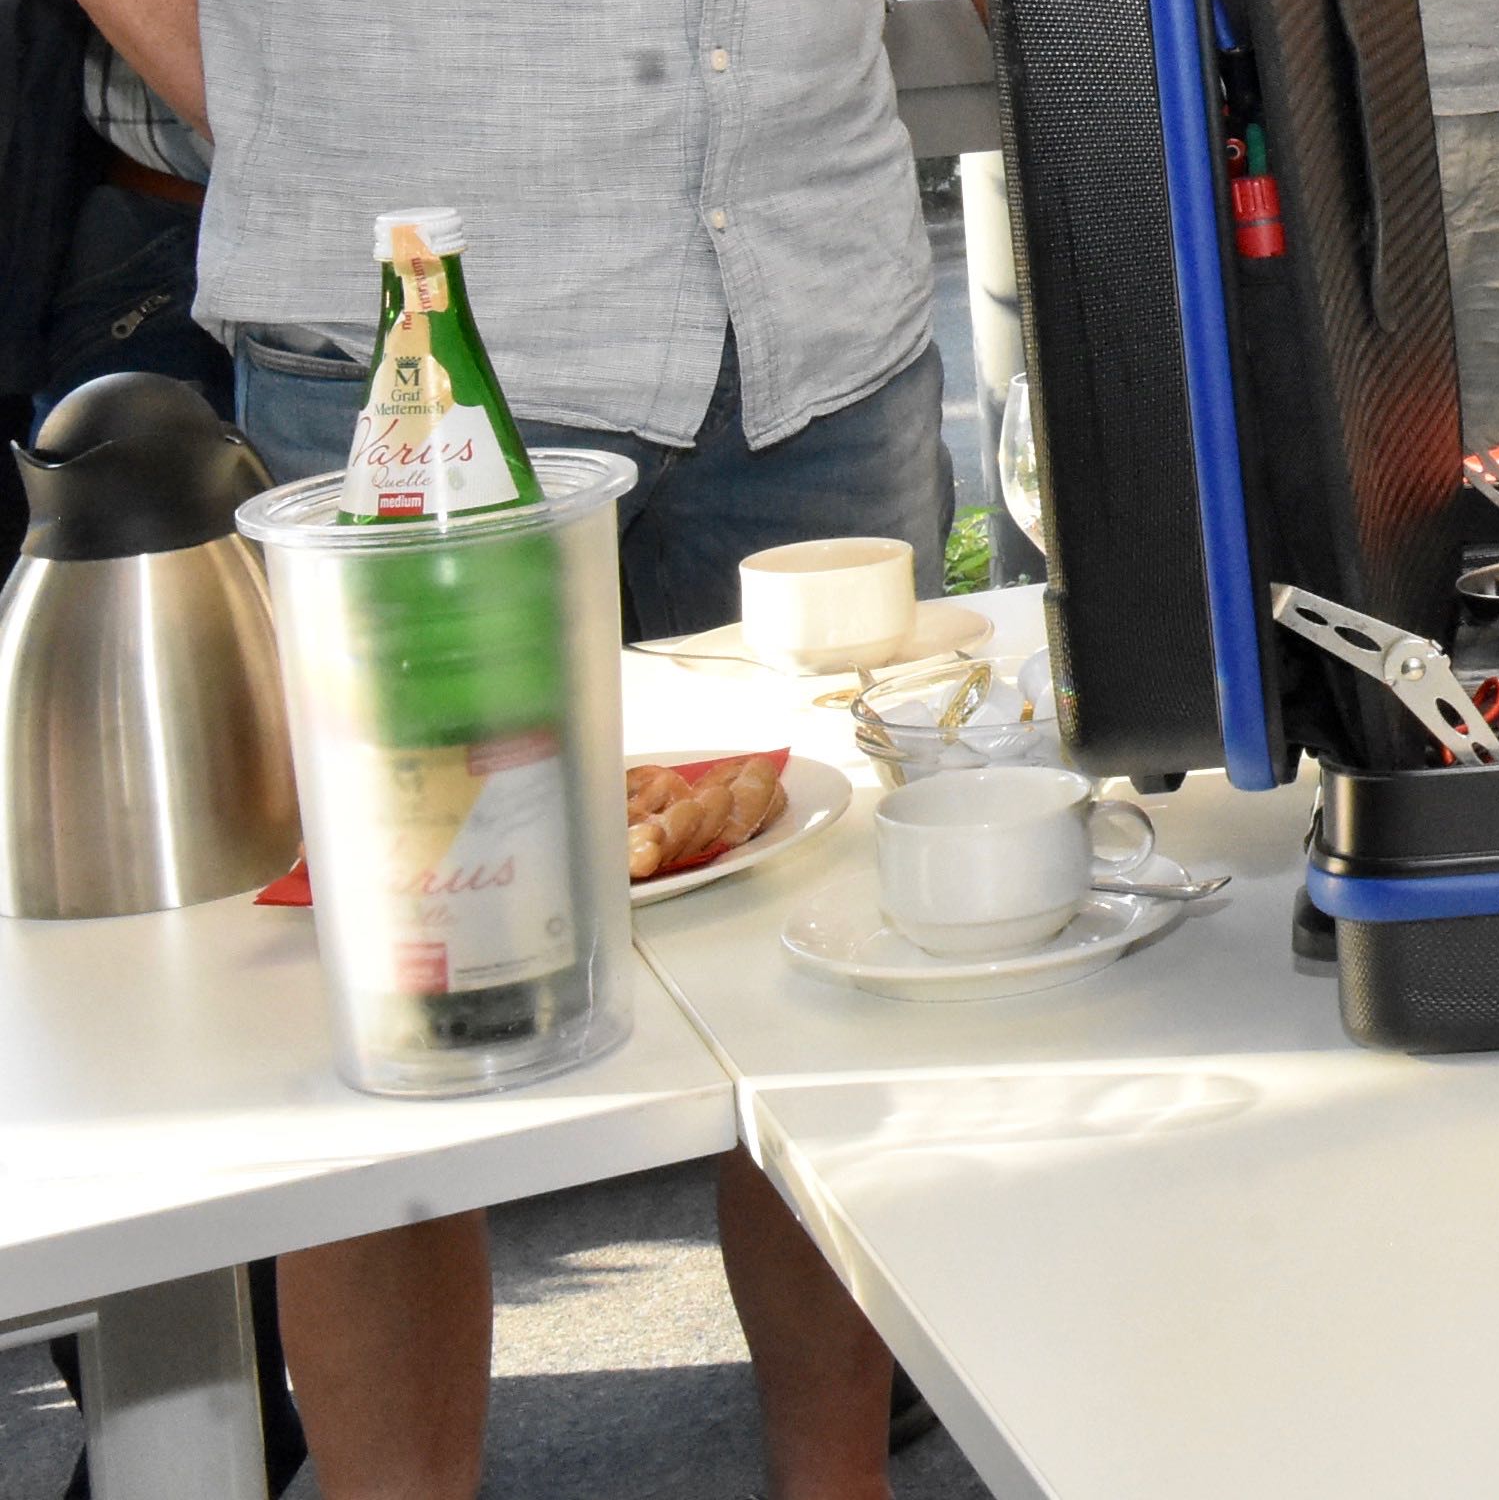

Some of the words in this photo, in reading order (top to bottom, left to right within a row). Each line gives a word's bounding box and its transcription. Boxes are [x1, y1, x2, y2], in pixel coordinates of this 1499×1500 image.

[390, 388, 422, 400] Graf
[374, 400, 445, 416] Metternich
[352, 415, 474, 468] Varus
[371, 465, 433, 489] Quelle
[379, 493, 423, 510] medium
